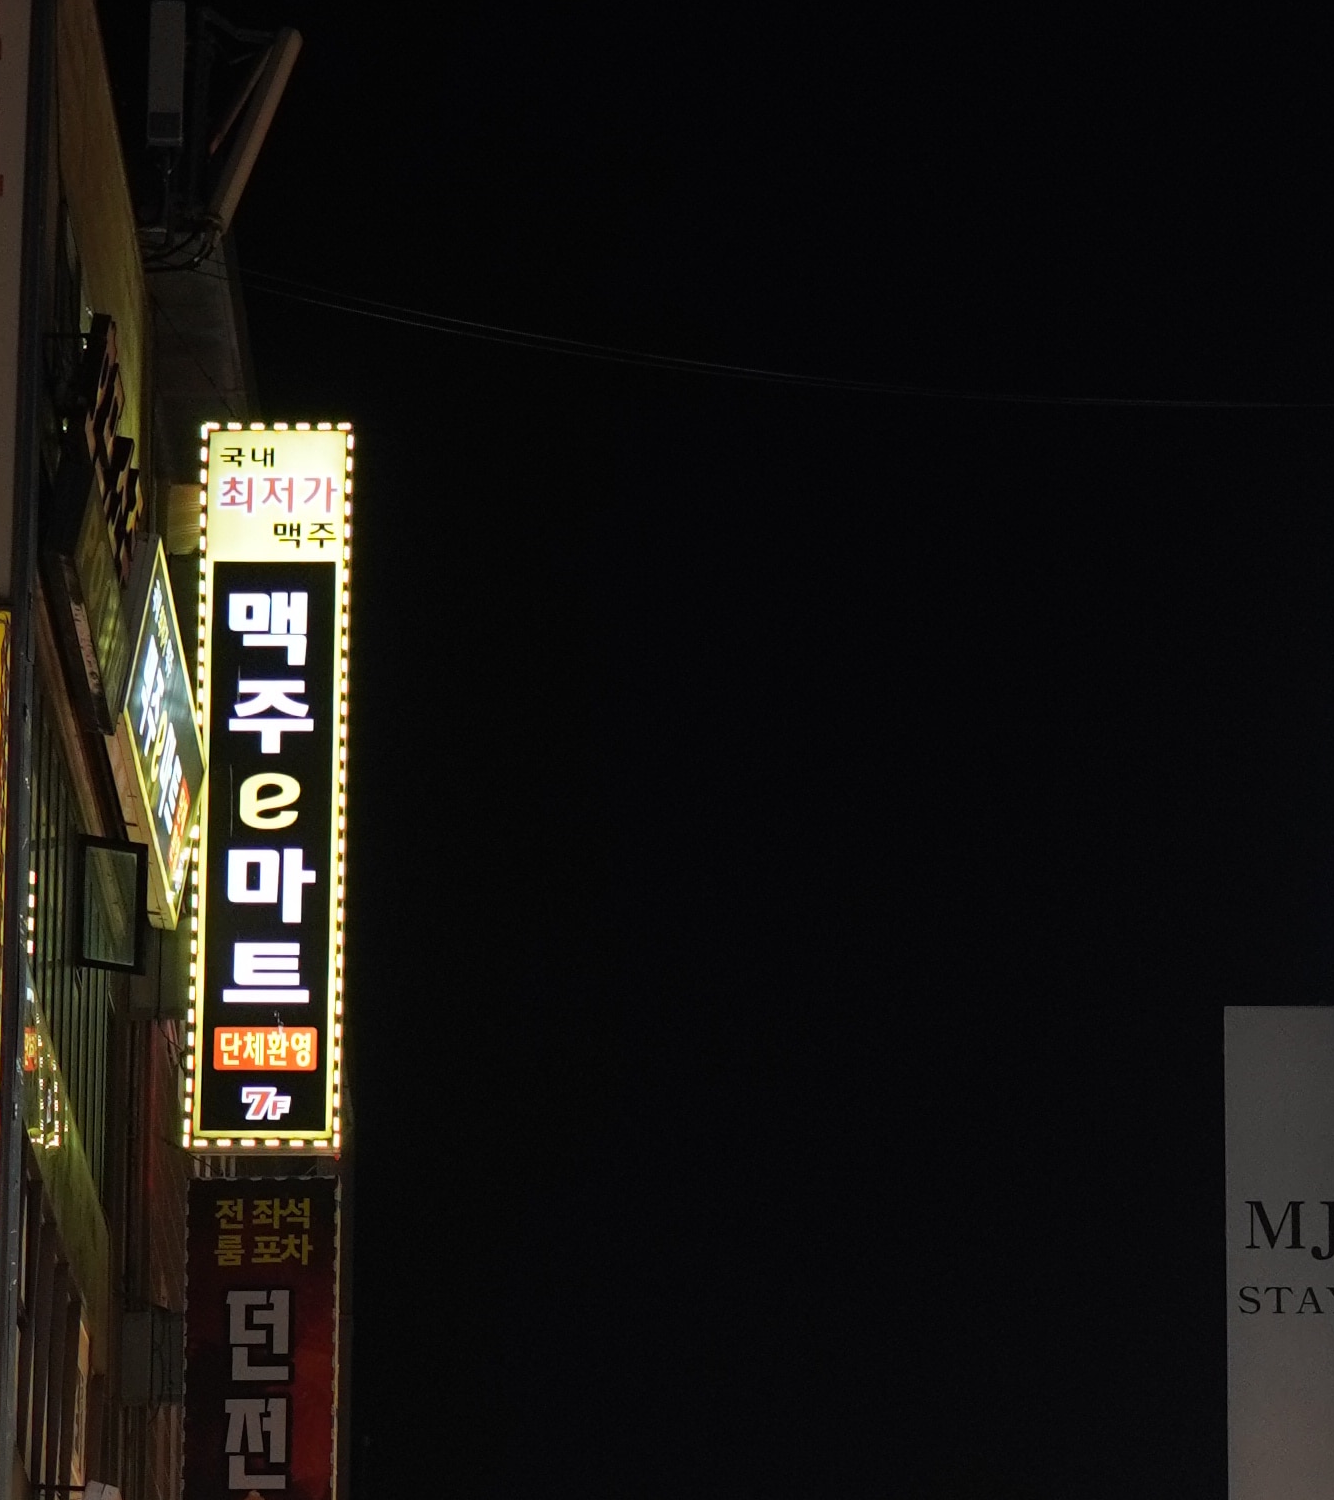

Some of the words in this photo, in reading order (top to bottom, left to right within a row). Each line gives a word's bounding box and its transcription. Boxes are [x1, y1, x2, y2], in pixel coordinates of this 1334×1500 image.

[220, 447, 276, 470] 국내
[219, 476, 338, 514] 최저가
[272, 521, 338, 550] 맥주
[219, 1031, 318, 1068] 단체환영
[240, 1087, 292, 1122] 7F
